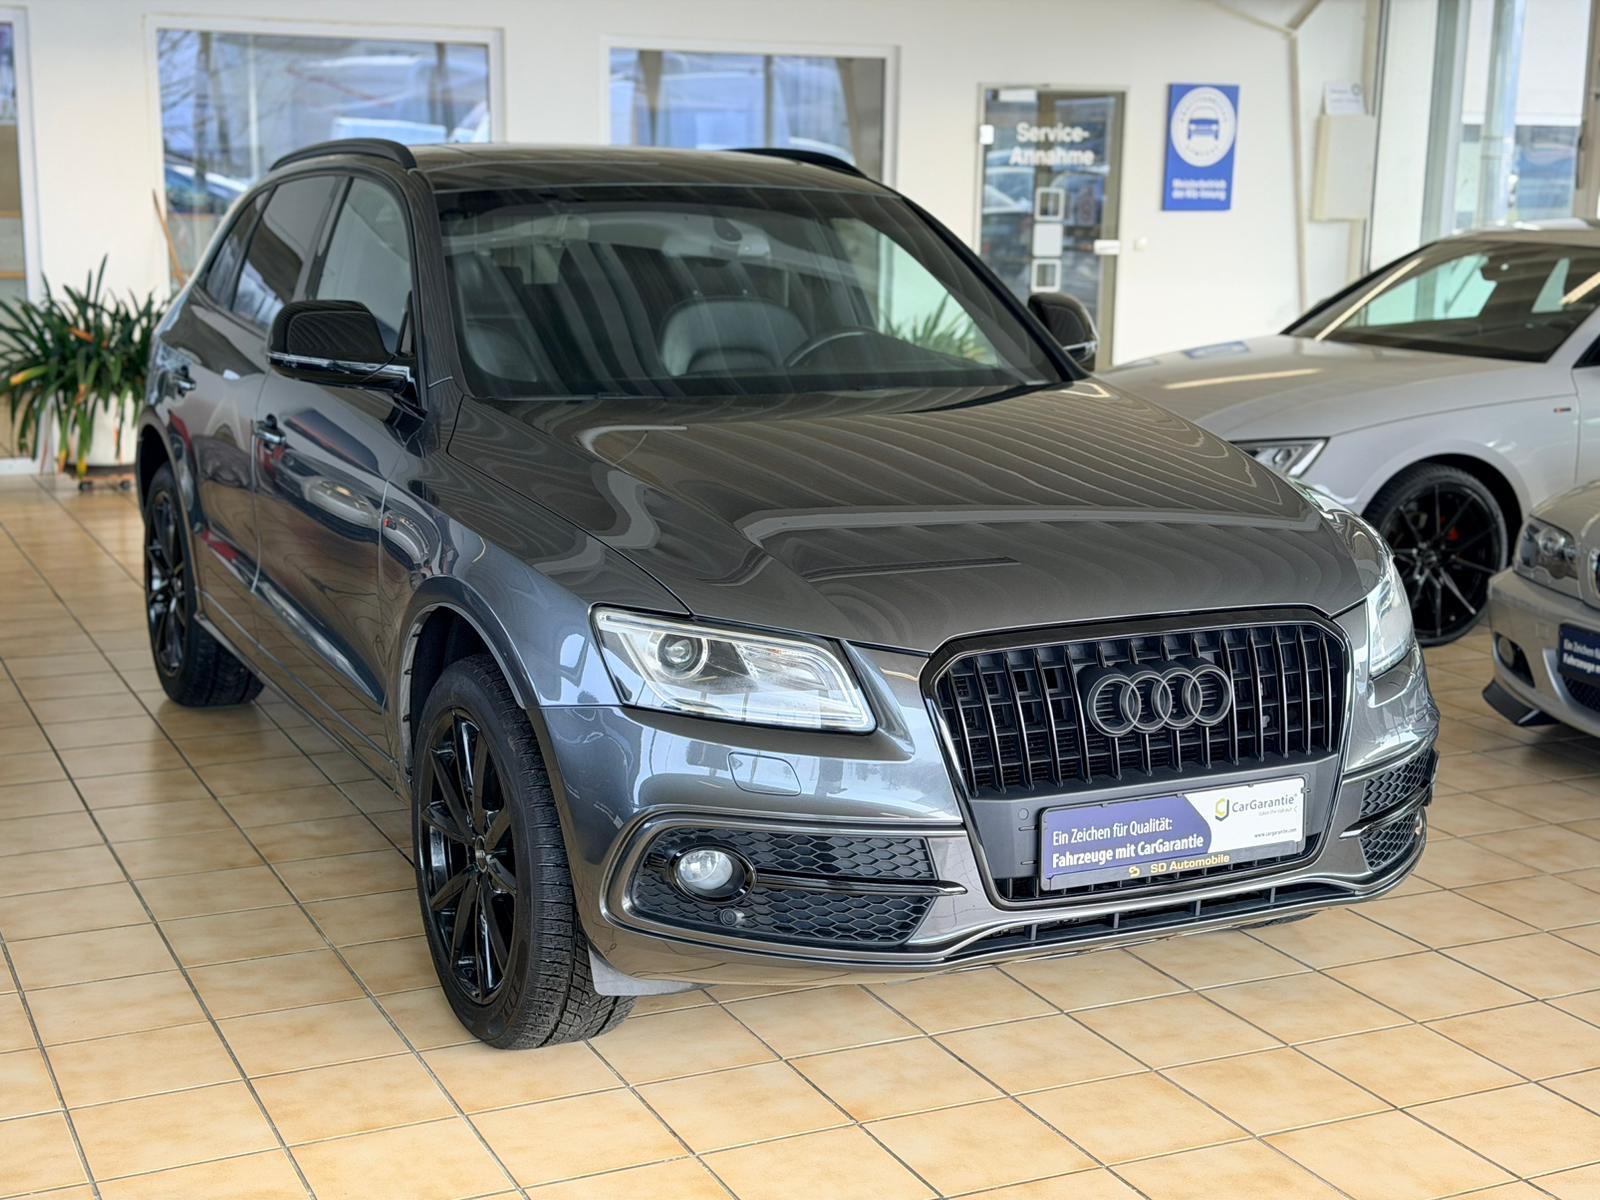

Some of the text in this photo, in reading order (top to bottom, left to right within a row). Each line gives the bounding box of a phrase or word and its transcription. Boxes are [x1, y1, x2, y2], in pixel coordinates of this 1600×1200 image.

[1016, 122, 1090, 142] Service-
[1009, 146, 1095, 166] Annahme
[1231, 794, 1295, 813] CarGarantie
[1052, 817, 1173, 846] Ein Zeichen für Qualität:
[1052, 833, 1204, 868] Fahrzeuge mit CarGarantie
[1150, 854, 1230, 874] SD Automobile
